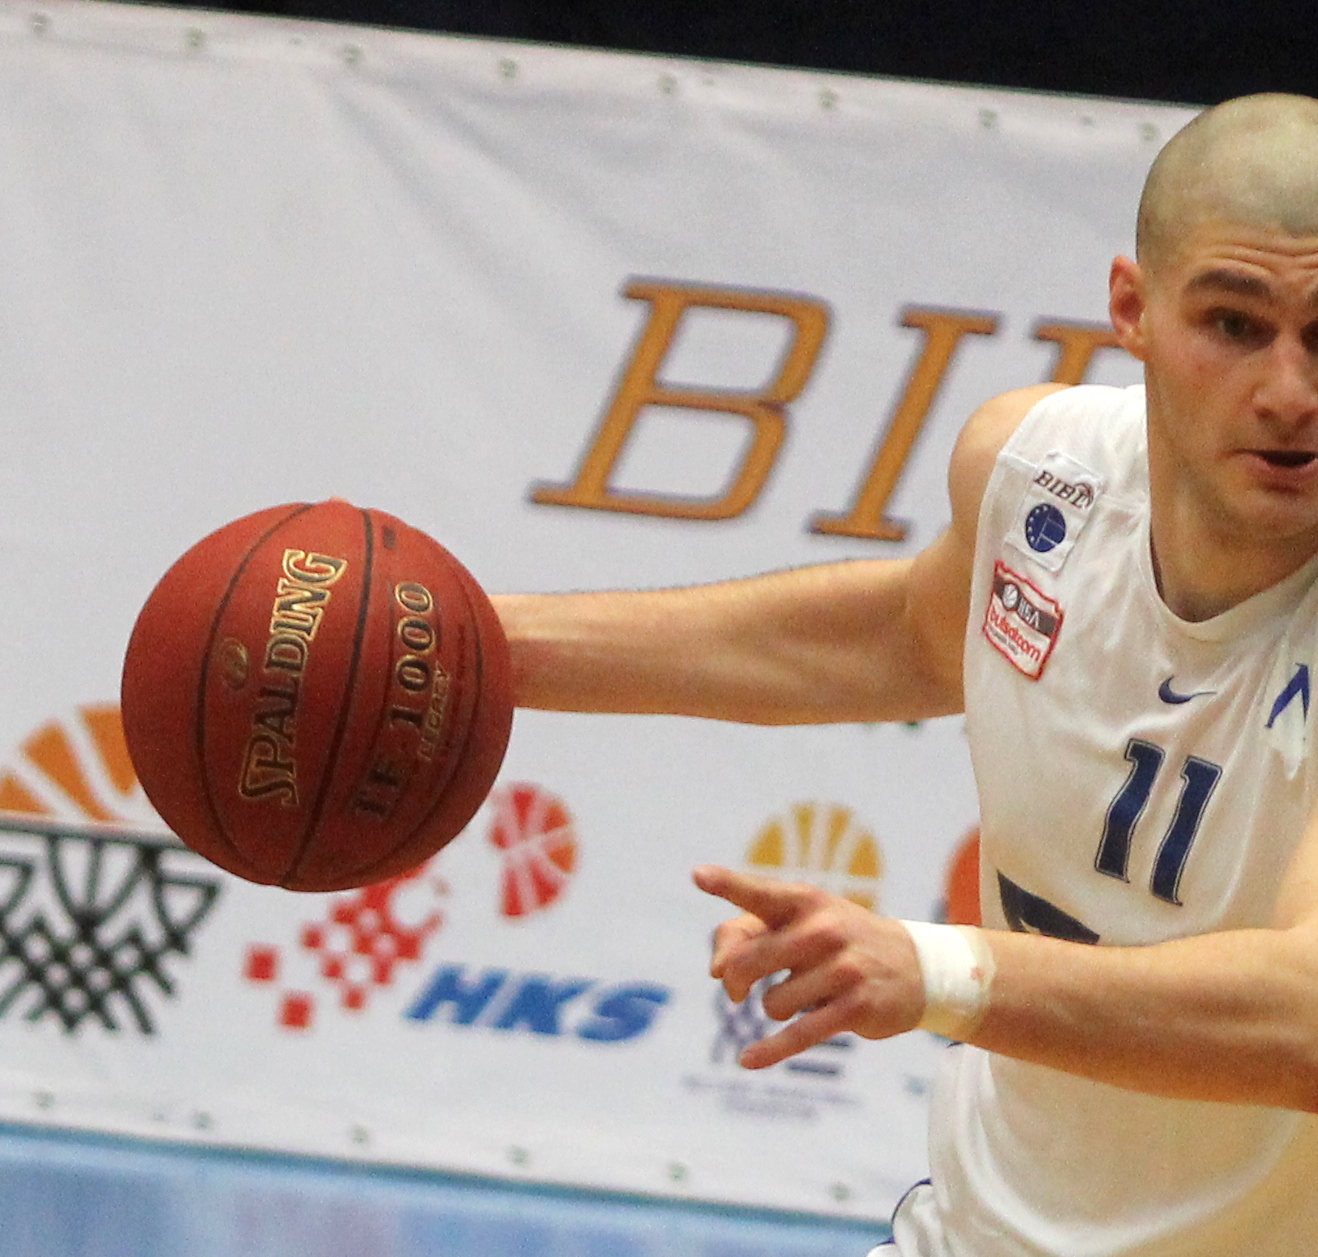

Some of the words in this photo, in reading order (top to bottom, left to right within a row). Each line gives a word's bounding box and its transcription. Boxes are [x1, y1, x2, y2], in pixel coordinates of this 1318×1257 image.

[238, 548, 347, 806] SPALDING
[389, 580, 435, 731] 1000
[1094, 737, 1222, 907] 11
[402, 963, 673, 1042] HKS
